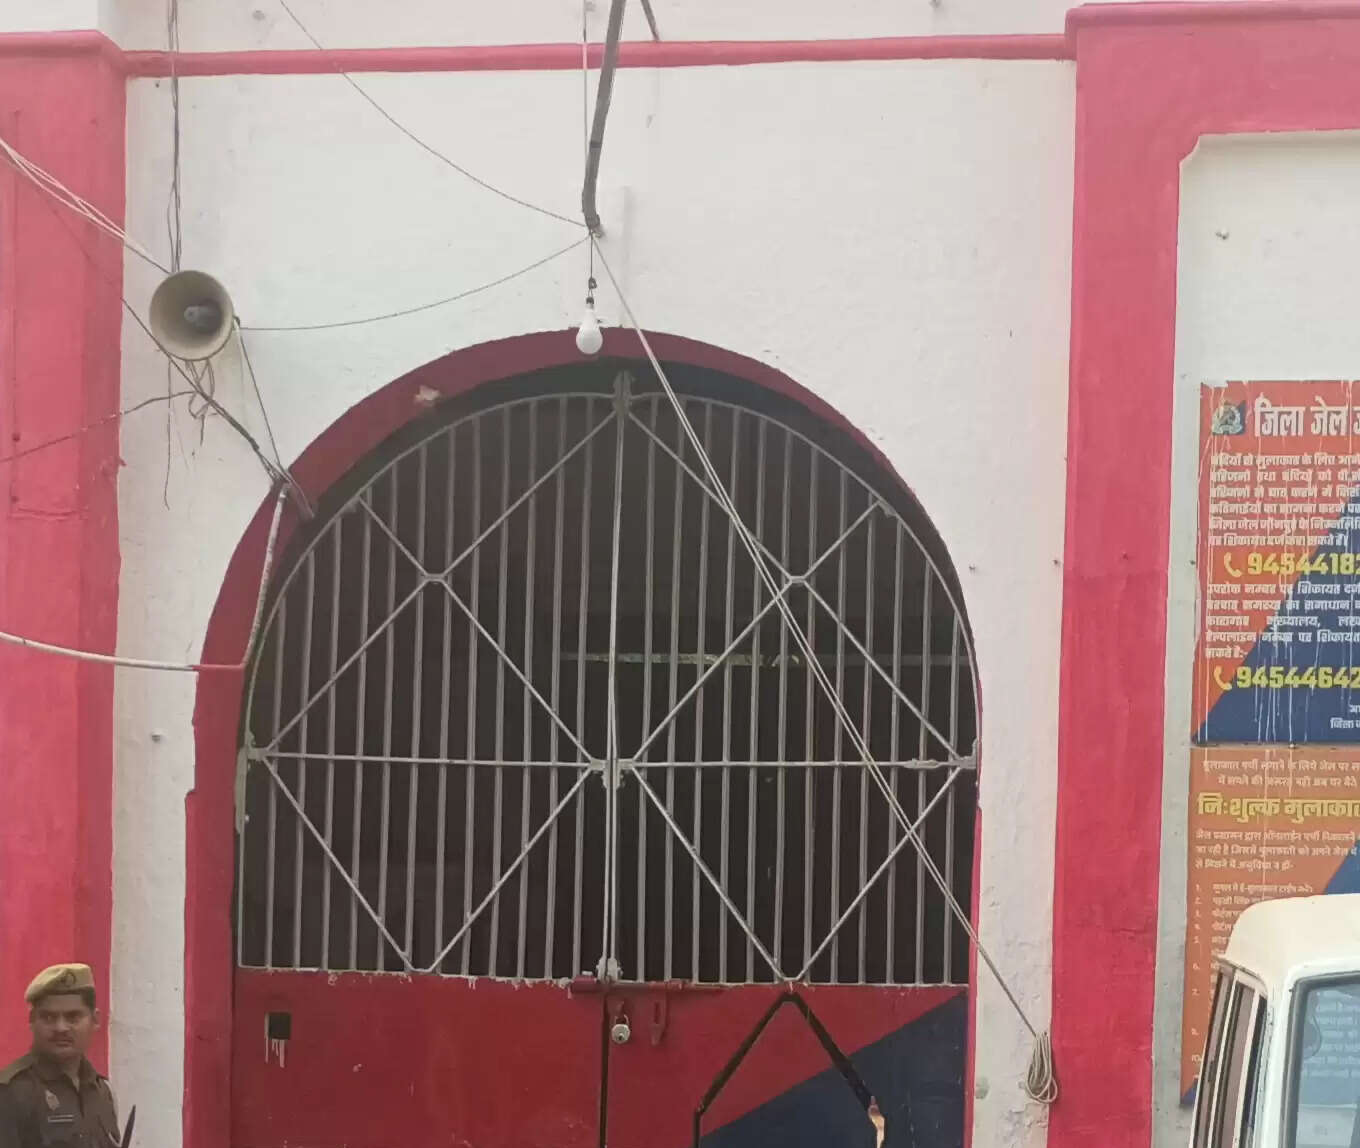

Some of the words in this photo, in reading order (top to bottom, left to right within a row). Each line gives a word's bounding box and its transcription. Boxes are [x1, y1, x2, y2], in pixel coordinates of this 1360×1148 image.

[1254, 392, 1304, 437] जिला
[1310, 396, 1348, 437] जेल
[1297, 581, 1340, 593] शिकायत
[1317, 629, 1360, 642] शिकायत
